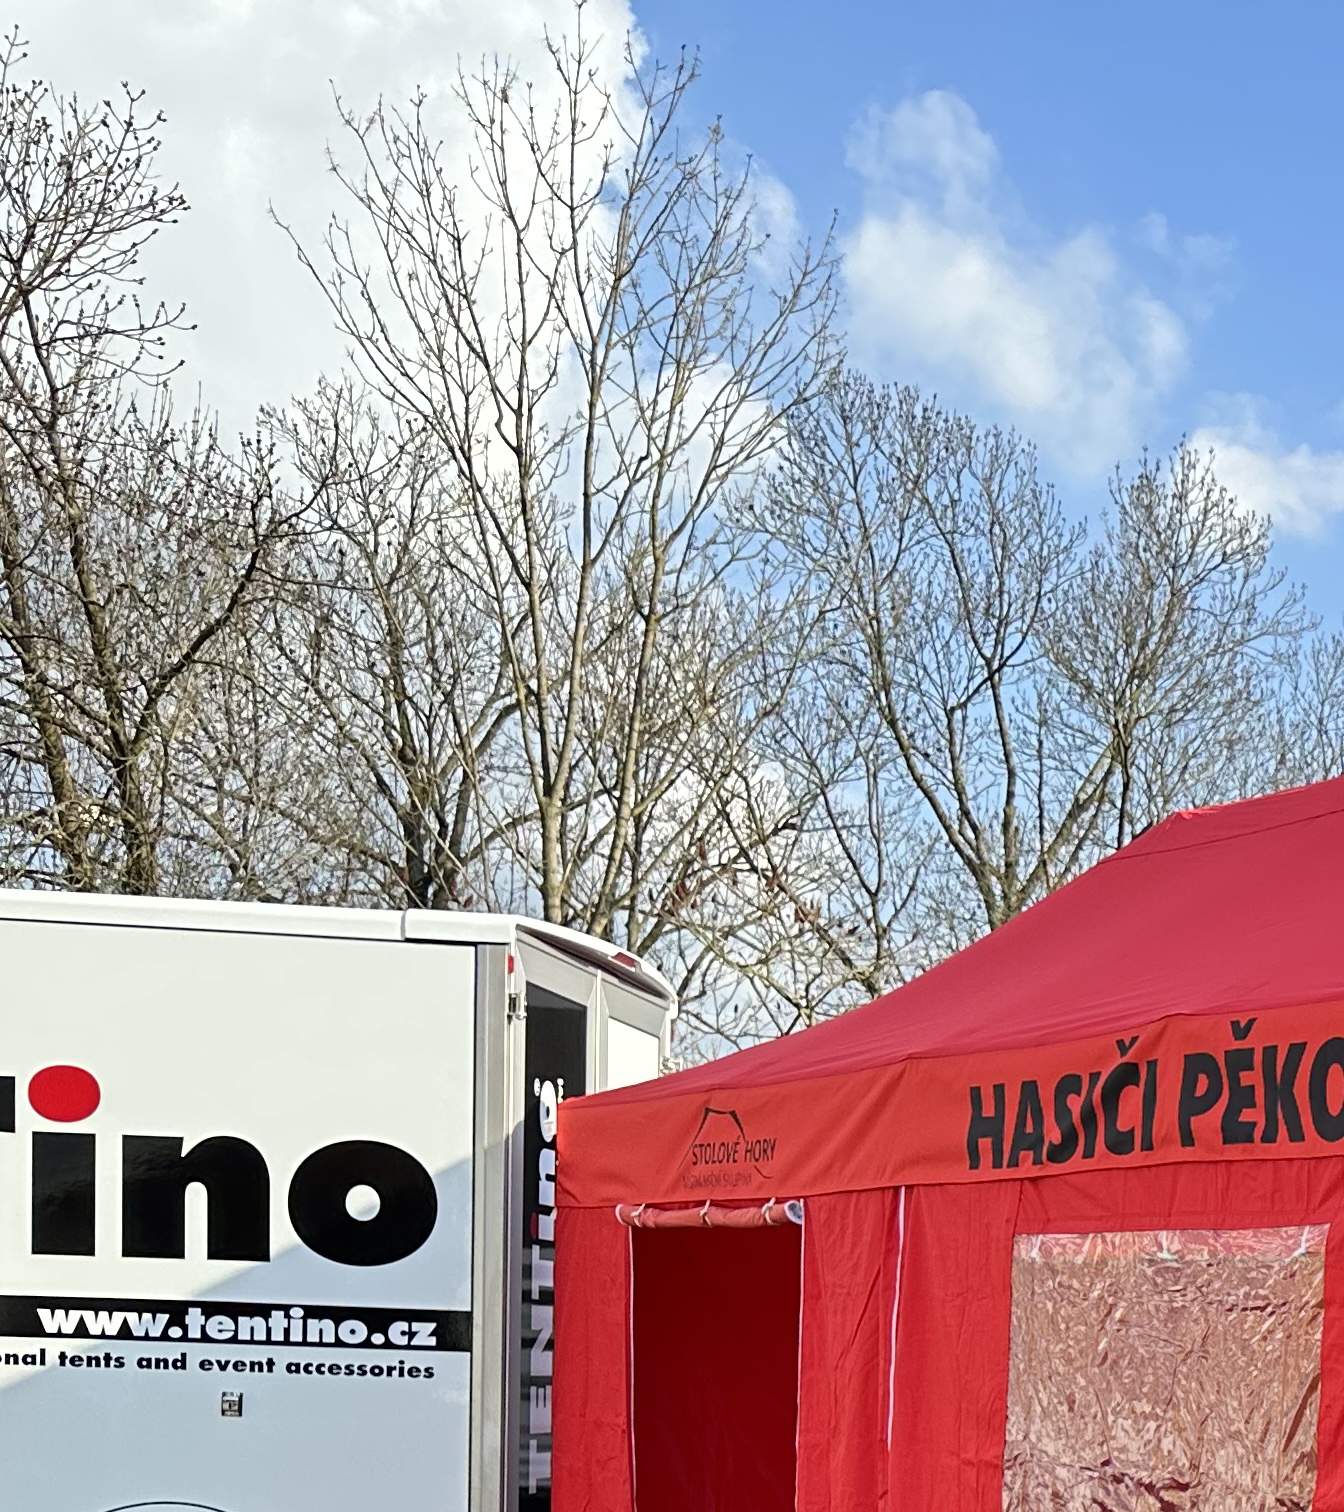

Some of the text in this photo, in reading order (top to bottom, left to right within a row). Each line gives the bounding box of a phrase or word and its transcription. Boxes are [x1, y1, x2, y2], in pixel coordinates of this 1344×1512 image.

[968, 1035, 1157, 1170] HASIČI
[0, 1065, 438, 1267] ino
[691, 1134, 778, 1166] STOLOVÉ HORY
[36, 1306, 438, 1347] www.tentino.cz
[0, 1348, 436, 1379] nal tents and event accessories
